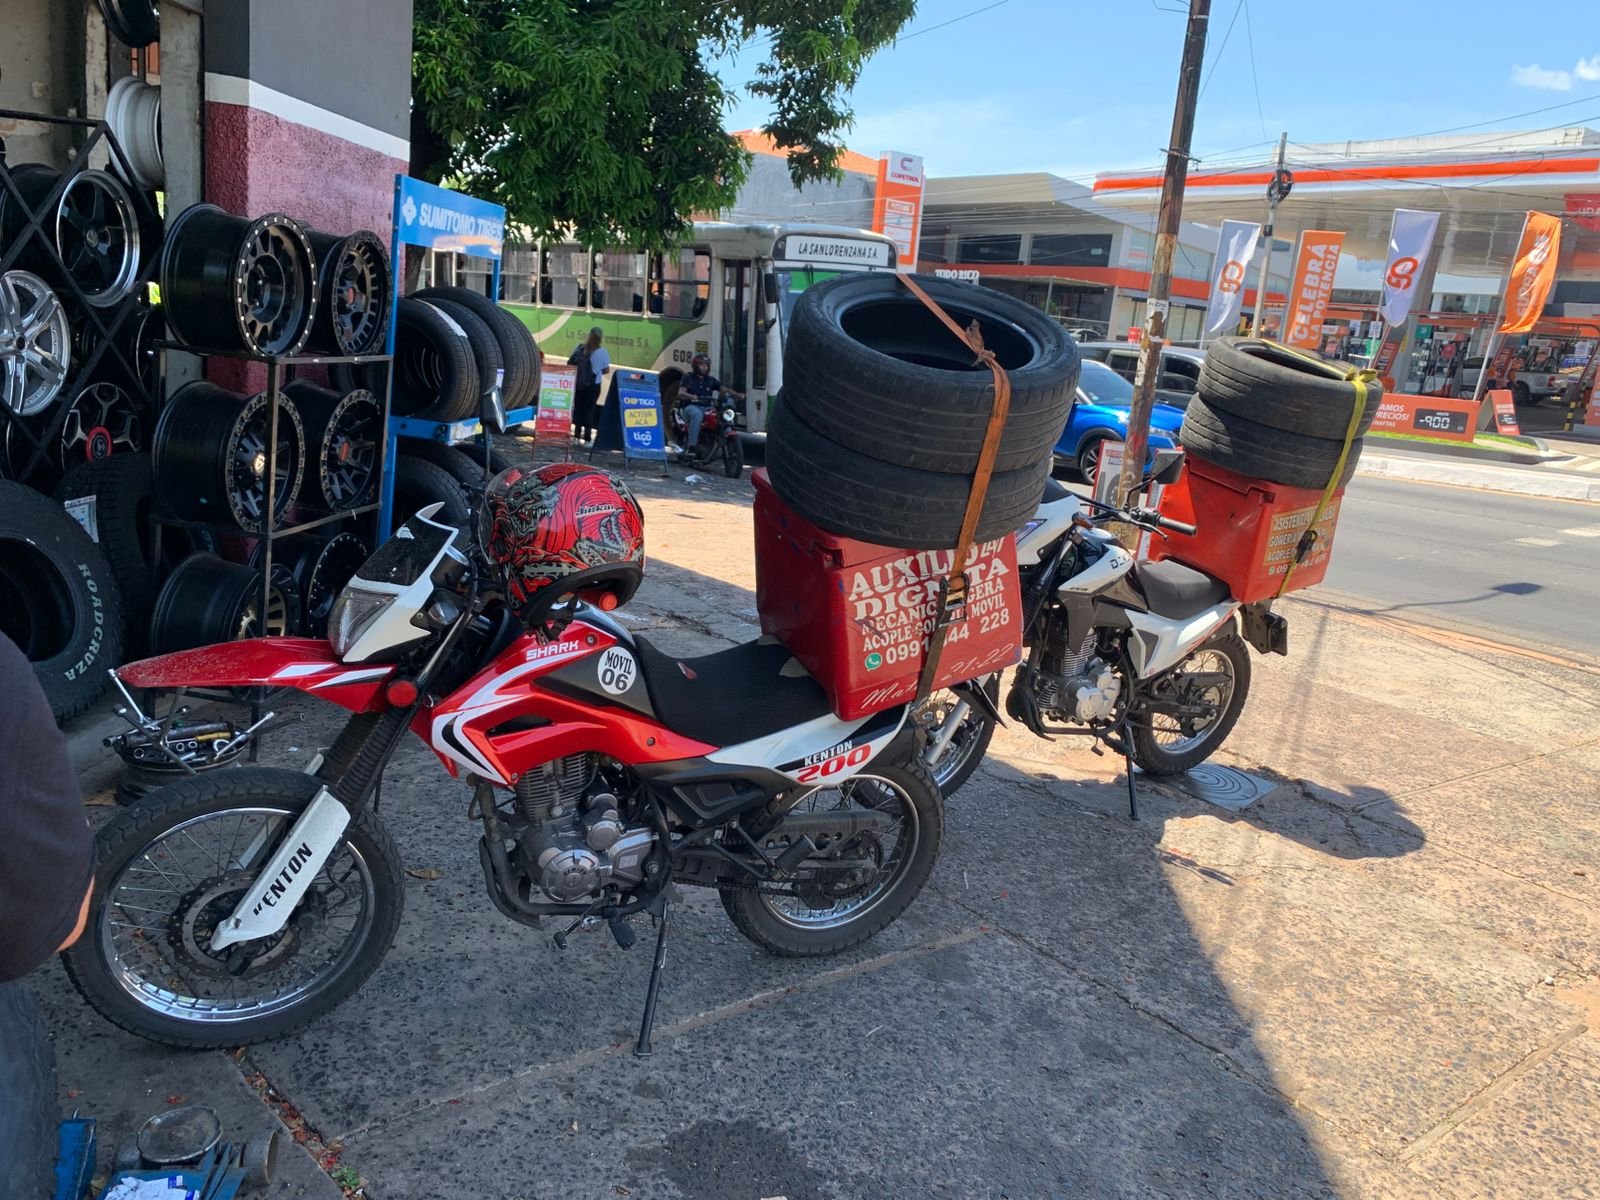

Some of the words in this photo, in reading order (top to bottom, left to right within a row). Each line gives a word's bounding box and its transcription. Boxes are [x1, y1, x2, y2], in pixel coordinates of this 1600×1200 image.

[891, 172, 919, 184] COPETROL
[419, 203, 476, 235] SUMITOMO
[477, 218, 503, 239] TIRES
[798, 243, 808, 255] LA
[1313, 245, 1340, 319] POTENCIA
[1311, 324, 1321, 341] LA
[673, 349, 693, 363] 608
[639, 398, 655, 406] TIGO
[1378, 404, 1405, 413] AMOS
[64, 562, 104, 682] ROADCRUZA
[862, 601, 938, 635] MECANIC
[863, 626, 913, 652] ACOPLE
[971, 593, 1006, 619] MOVIL
[943, 622, 970, 647] 44
[980, 608, 1010, 634] 228
[526, 640, 580, 661] SHARK
[604, 650, 633, 675] MOVIL
[601, 668, 629, 692] 06
[796, 743, 872, 783] 200
[804, 740, 854, 767] KENTON
